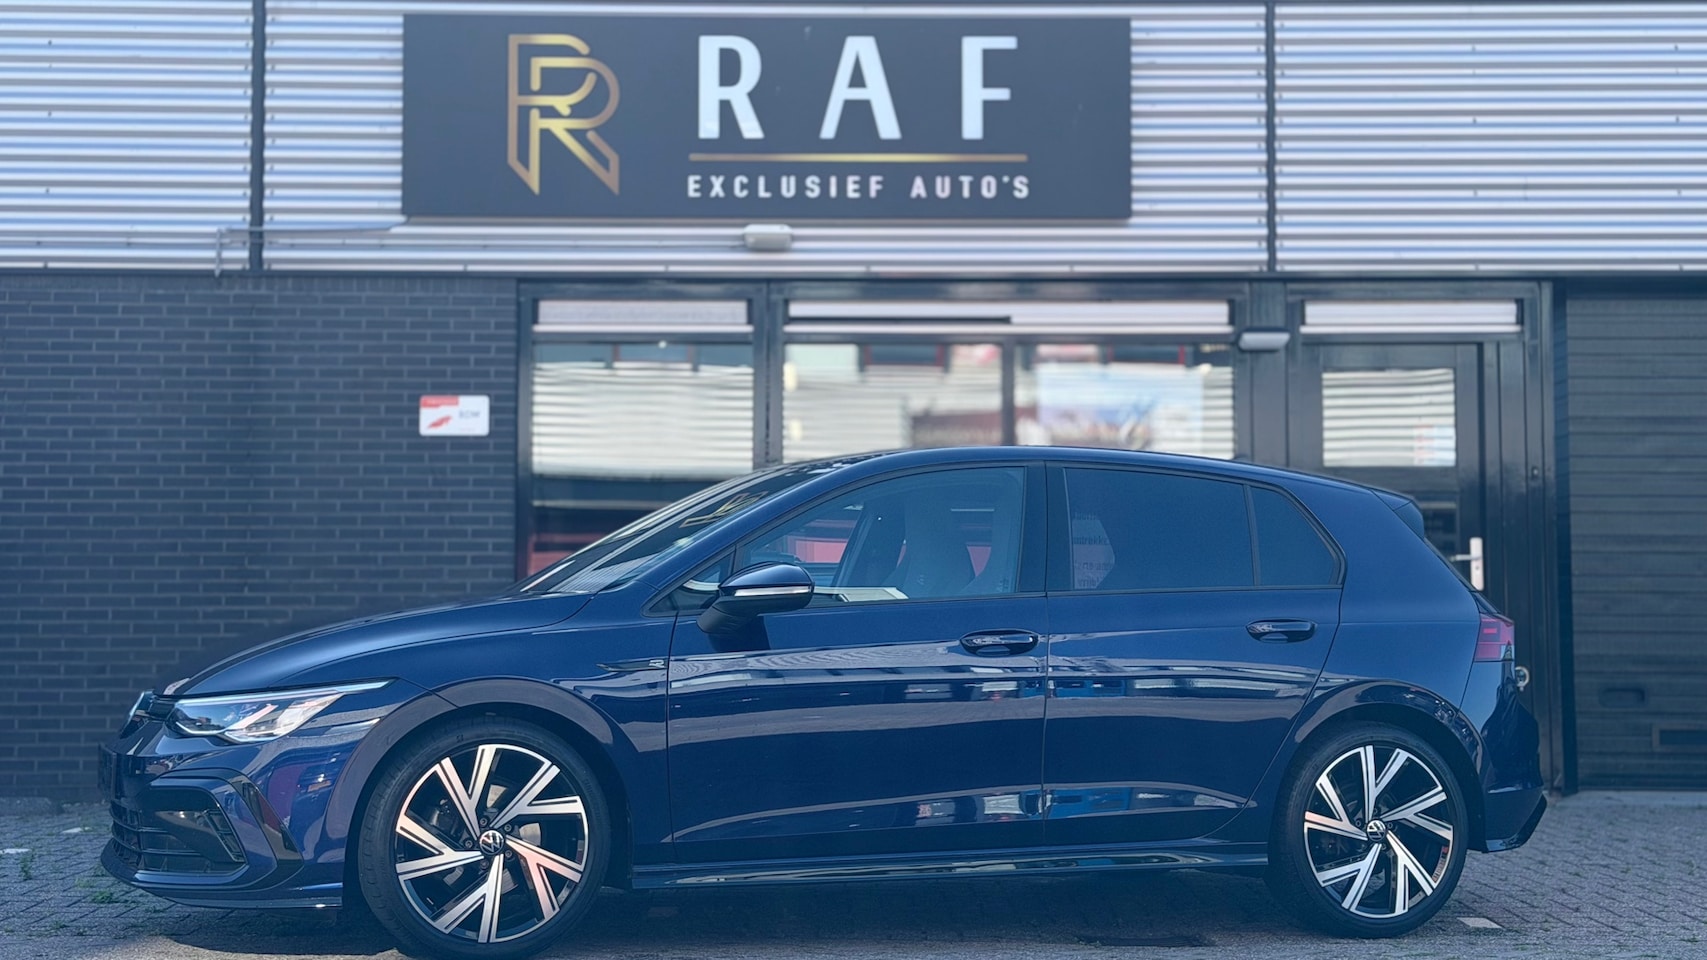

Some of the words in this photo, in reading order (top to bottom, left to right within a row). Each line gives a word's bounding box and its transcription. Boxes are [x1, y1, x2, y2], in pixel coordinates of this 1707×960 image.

[698, 35, 1018, 140] RAF
[687, 175, 883, 199] EXCLUSIEF
[910, 175, 1030, 199] AUTO'S
